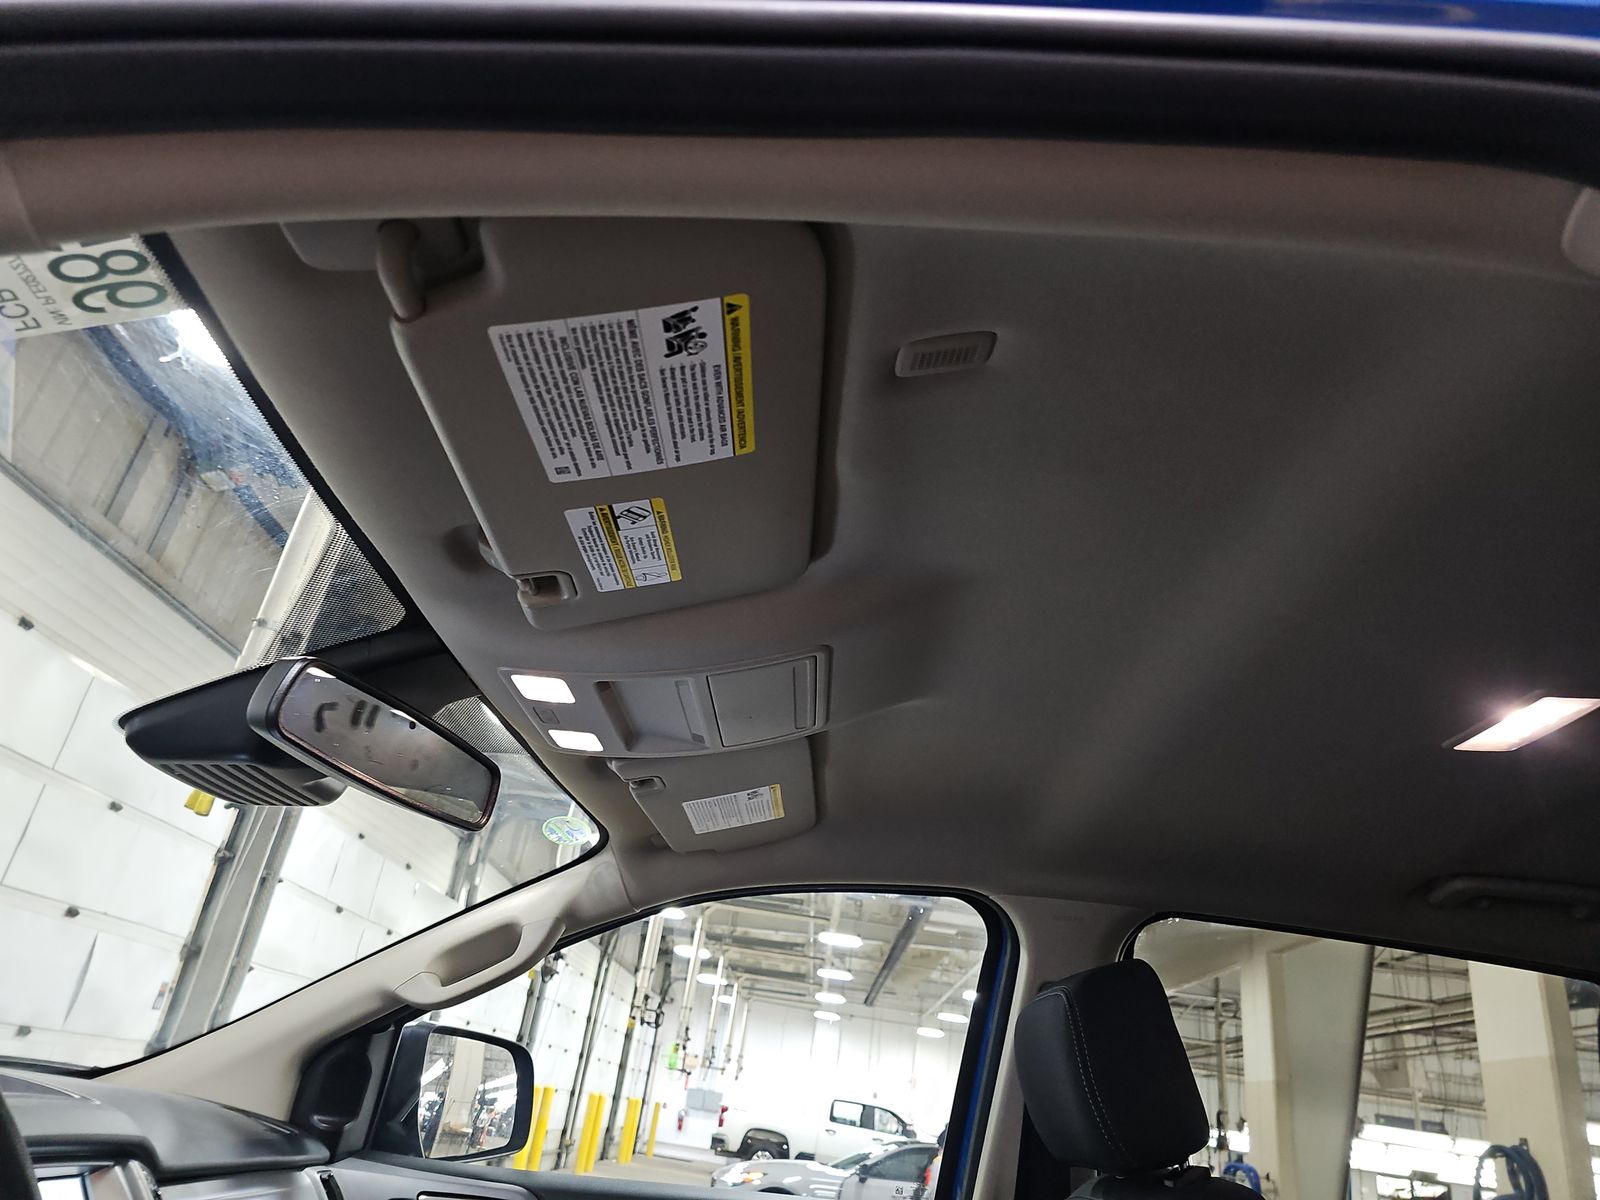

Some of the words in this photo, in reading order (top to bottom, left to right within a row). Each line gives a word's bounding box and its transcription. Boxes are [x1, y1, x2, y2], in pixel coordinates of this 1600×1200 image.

[728, 316, 741, 352] WARNING
[629, 340, 642, 358] AVEC
[633, 358, 645, 372] DES
[711, 363, 722, 380] EVEN
[568, 371, 581, 386] CON
[636, 372, 649, 389] SACS
[572, 386, 585, 398] LAS
[713, 380, 723, 395] WITH
[576, 398, 592, 420] NUEVAS
[640, 389, 656, 425] GONFLABLES
[715, 395, 726, 423] ADVANCED
[583, 420, 598, 442] BOLSAS
[718, 423, 727, 432] AIR
[719, 432, 728, 447] BAGS
